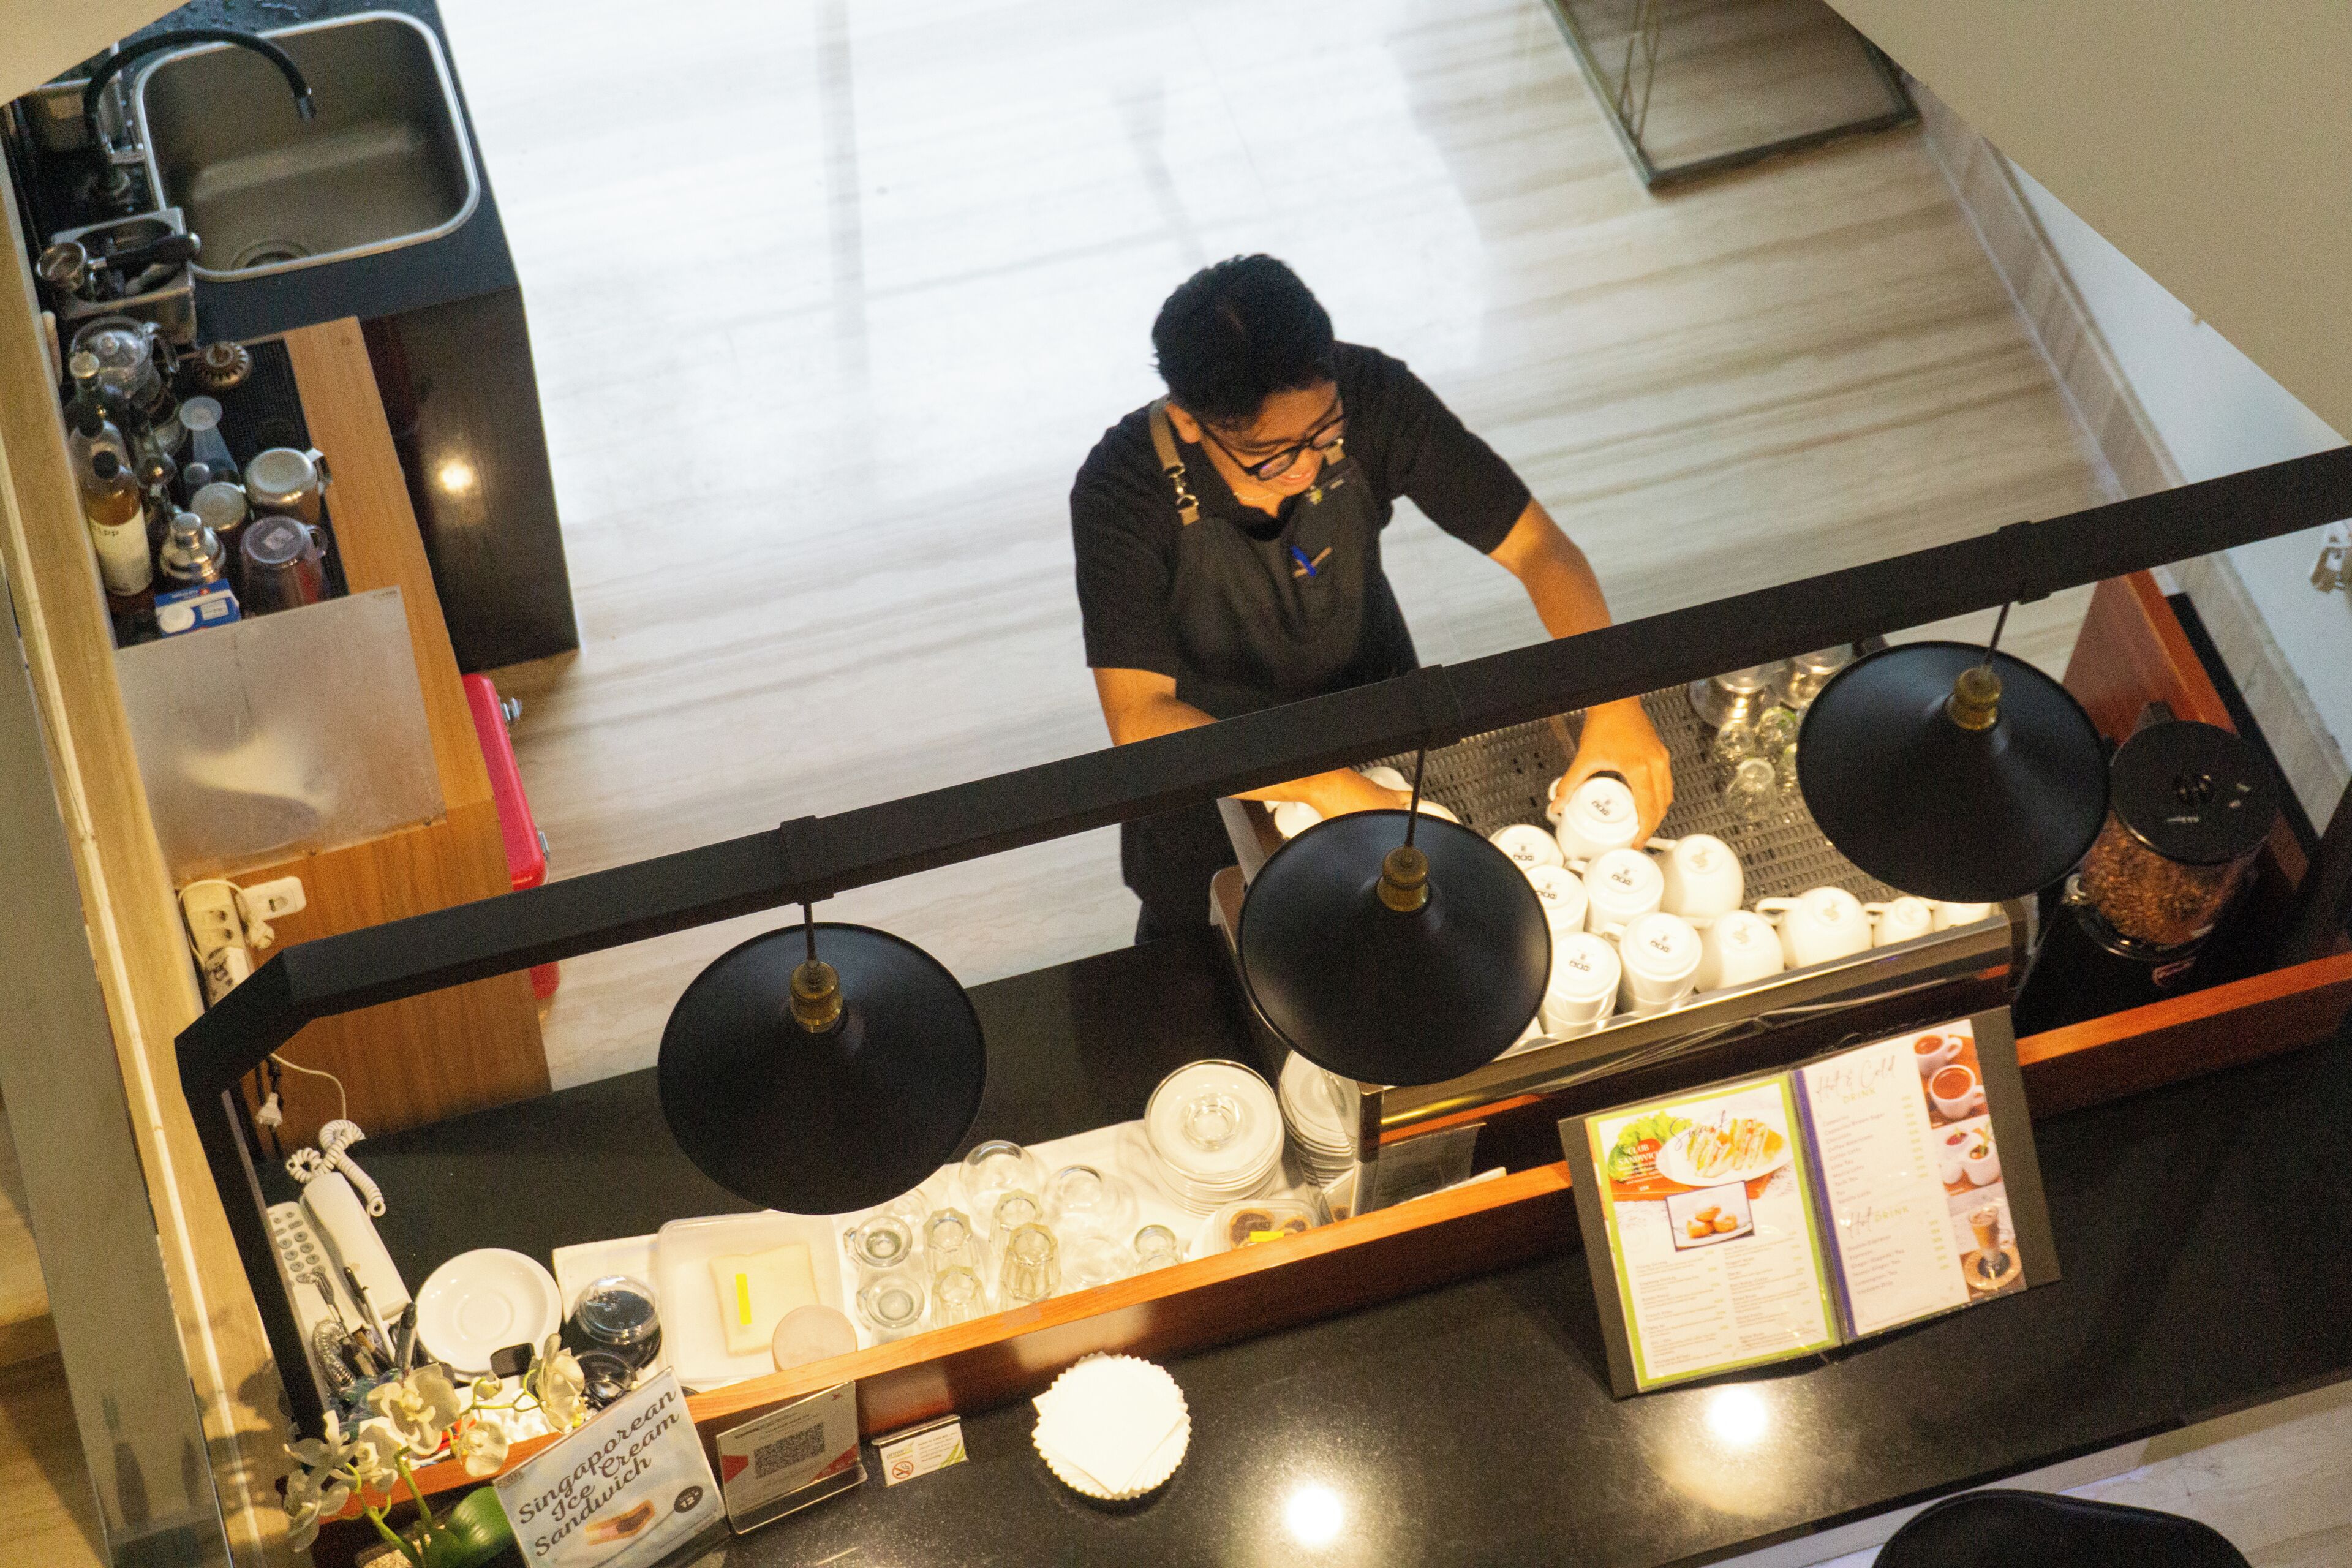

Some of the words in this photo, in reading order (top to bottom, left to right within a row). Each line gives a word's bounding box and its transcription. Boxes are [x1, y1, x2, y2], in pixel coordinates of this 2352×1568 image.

[1816, 1070, 1841, 1103] Hot
[1860, 1055, 1896, 1088] Cold
[1842, 1087, 1876, 1104] DRINK
[1627, 1144, 1650, 1156] CLUB
[1847, 1205, 1872, 1239] Hot
[1874, 1205, 1909, 1223] DRINK
[519, 1390, 676, 1524] Singaporean
[552, 1485, 595, 1522] Ice
[598, 1413, 679, 1479] Cream
[535, 1456, 651, 1556] Sandwich
